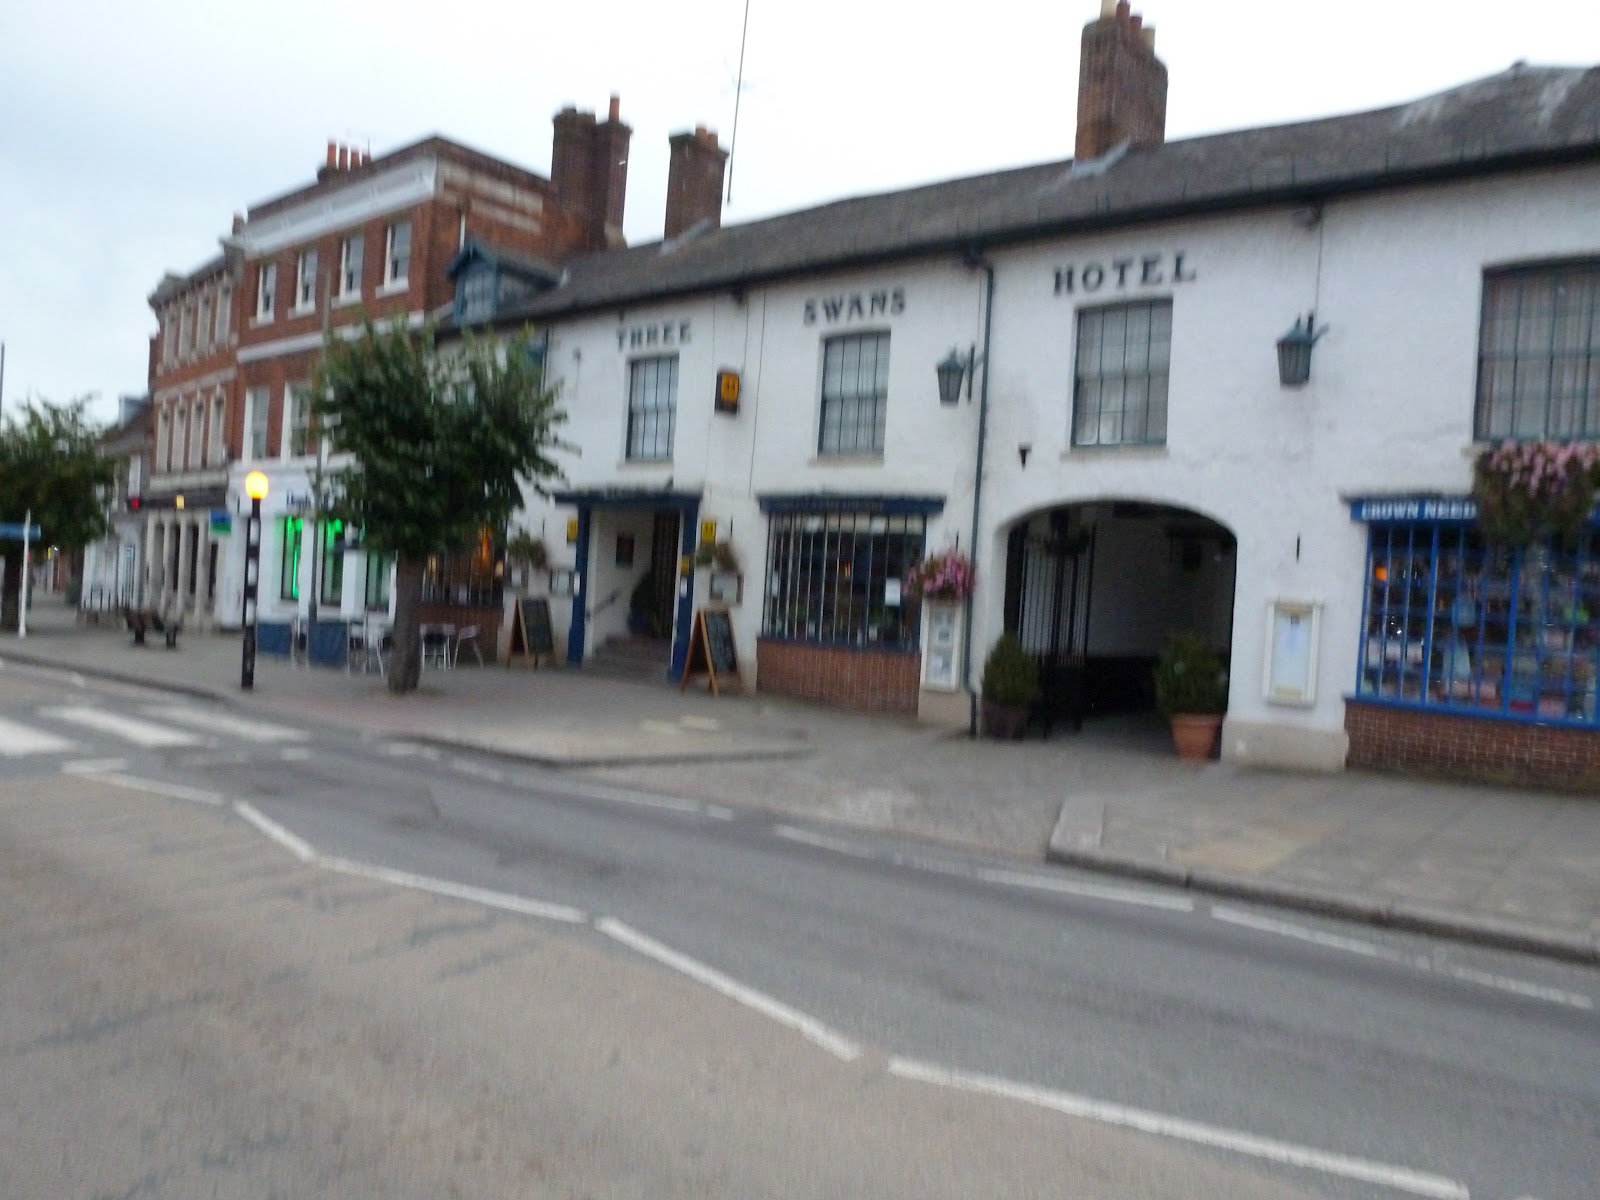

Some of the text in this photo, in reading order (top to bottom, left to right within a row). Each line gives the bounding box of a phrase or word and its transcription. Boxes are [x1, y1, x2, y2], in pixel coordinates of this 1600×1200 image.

[616, 252, 1197, 352] THREE SWANS HOTEL
